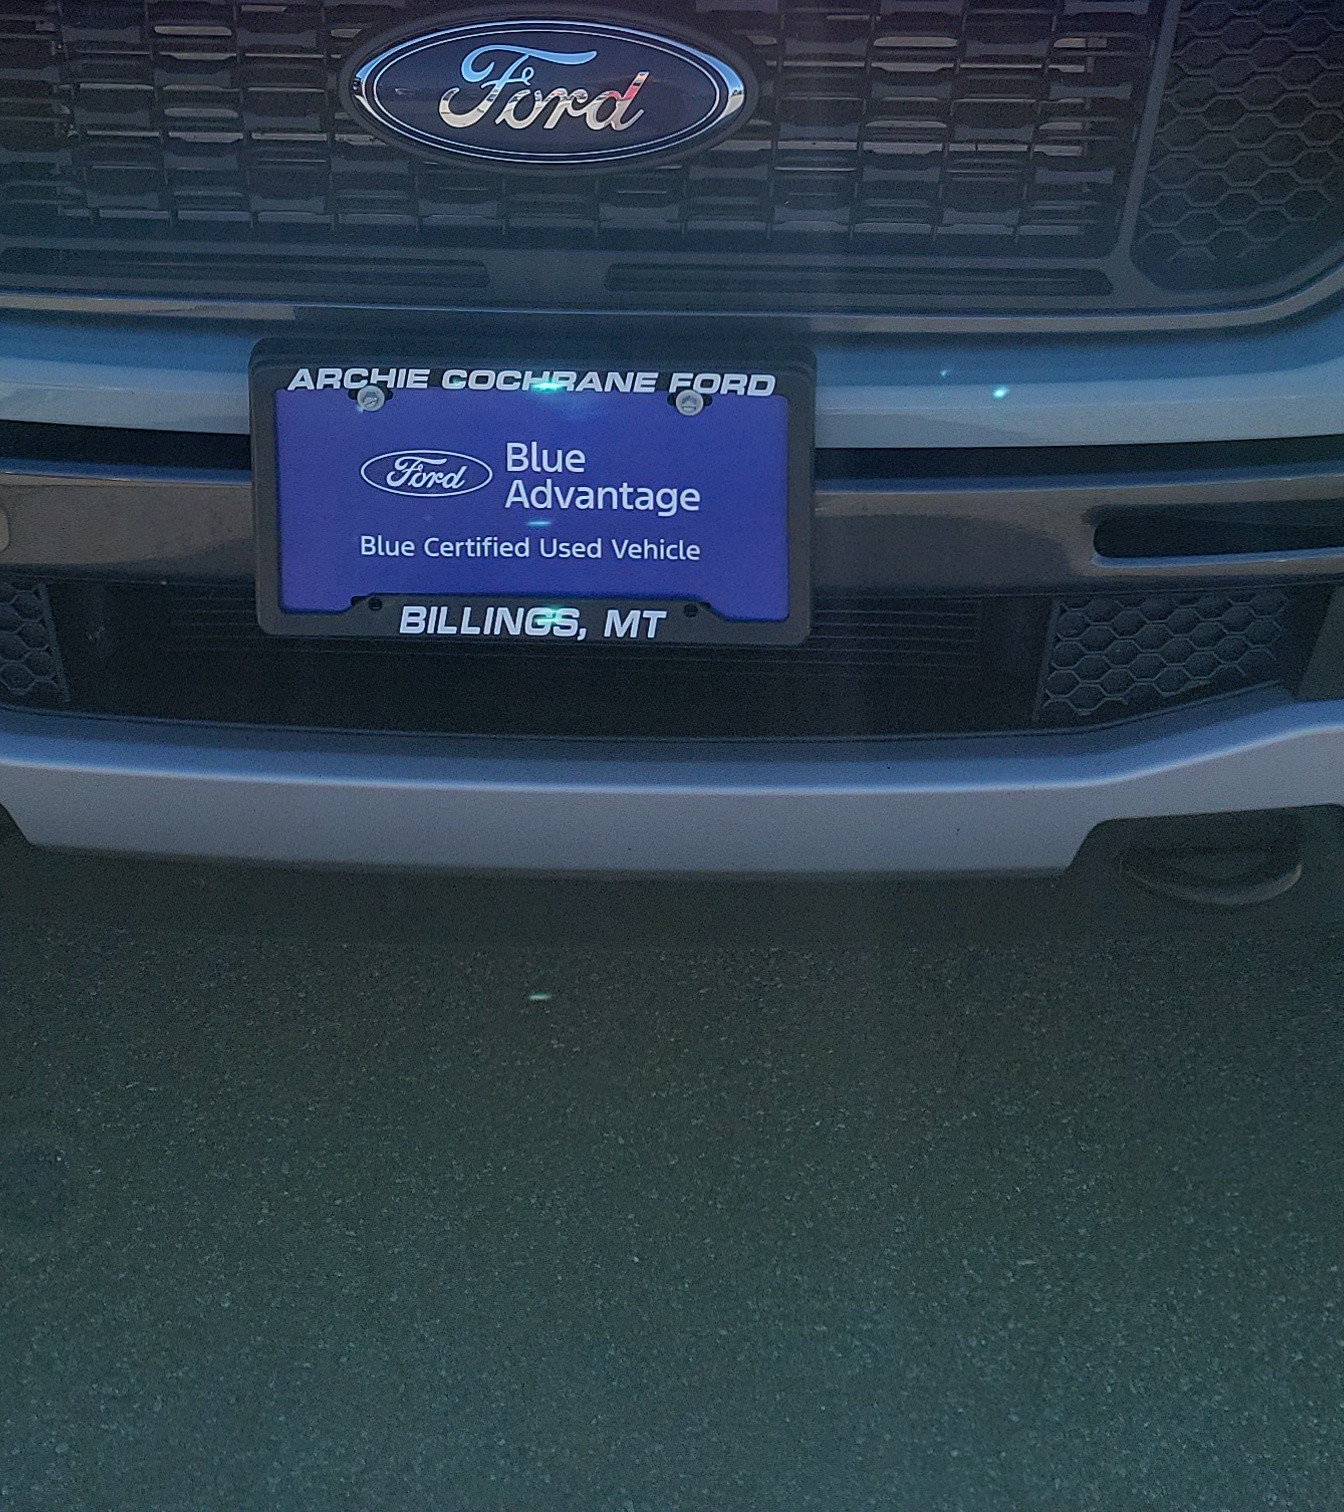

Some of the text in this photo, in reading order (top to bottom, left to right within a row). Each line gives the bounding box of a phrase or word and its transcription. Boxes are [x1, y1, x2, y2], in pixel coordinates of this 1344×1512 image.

[438, 44, 650, 131] Ford
[287, 368, 776, 397] ARCHIE COCHRANE FORD
[386, 456, 468, 489] Ford
[506, 441, 586, 473] Blue
[505, 478, 701, 517] Advantage
[360, 534, 701, 560] Blue Certified Used Vehicle
[399, 605, 667, 641] BILLINGS, MT
